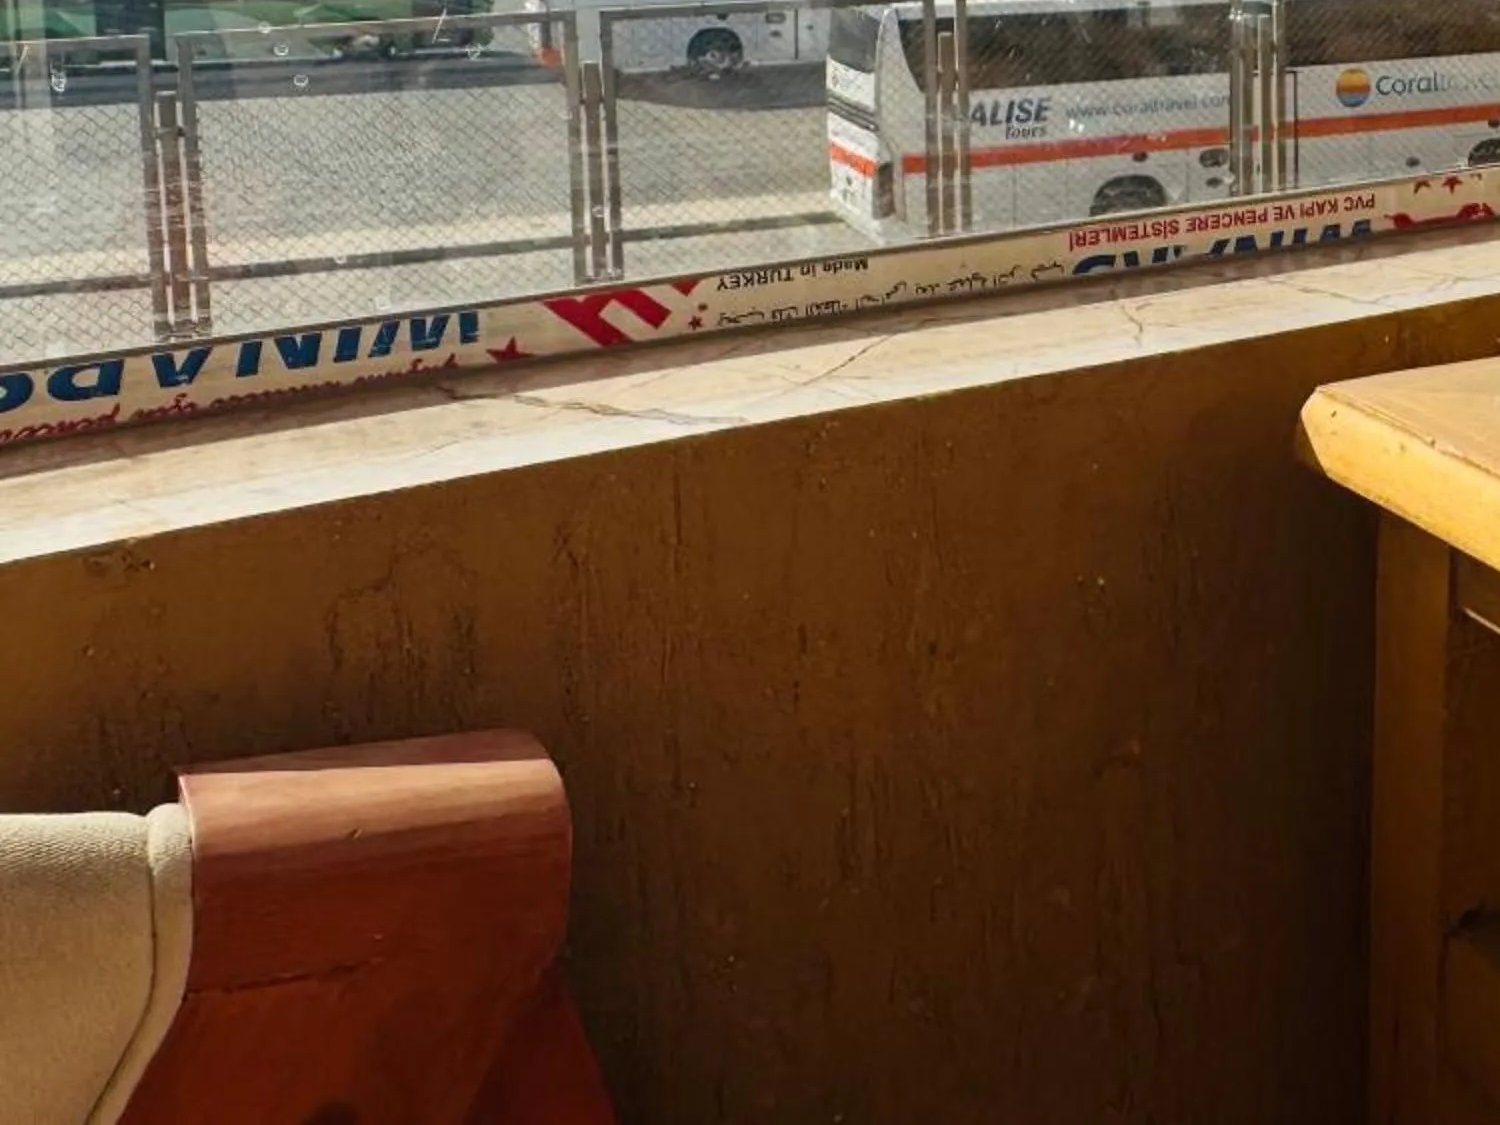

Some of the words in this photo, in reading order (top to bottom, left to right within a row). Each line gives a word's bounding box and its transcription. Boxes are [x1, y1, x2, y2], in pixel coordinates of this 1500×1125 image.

[1300, 197, 1340, 219] KAPI
[1343, 193, 1375, 212] PVC
[1185, 206, 1269, 234] PENCERE
[1273, 204, 1296, 222] VE
[800, 263, 817, 276] in
[822, 259, 869, 273] Made
[716, 268, 794, 292] TURKEY
